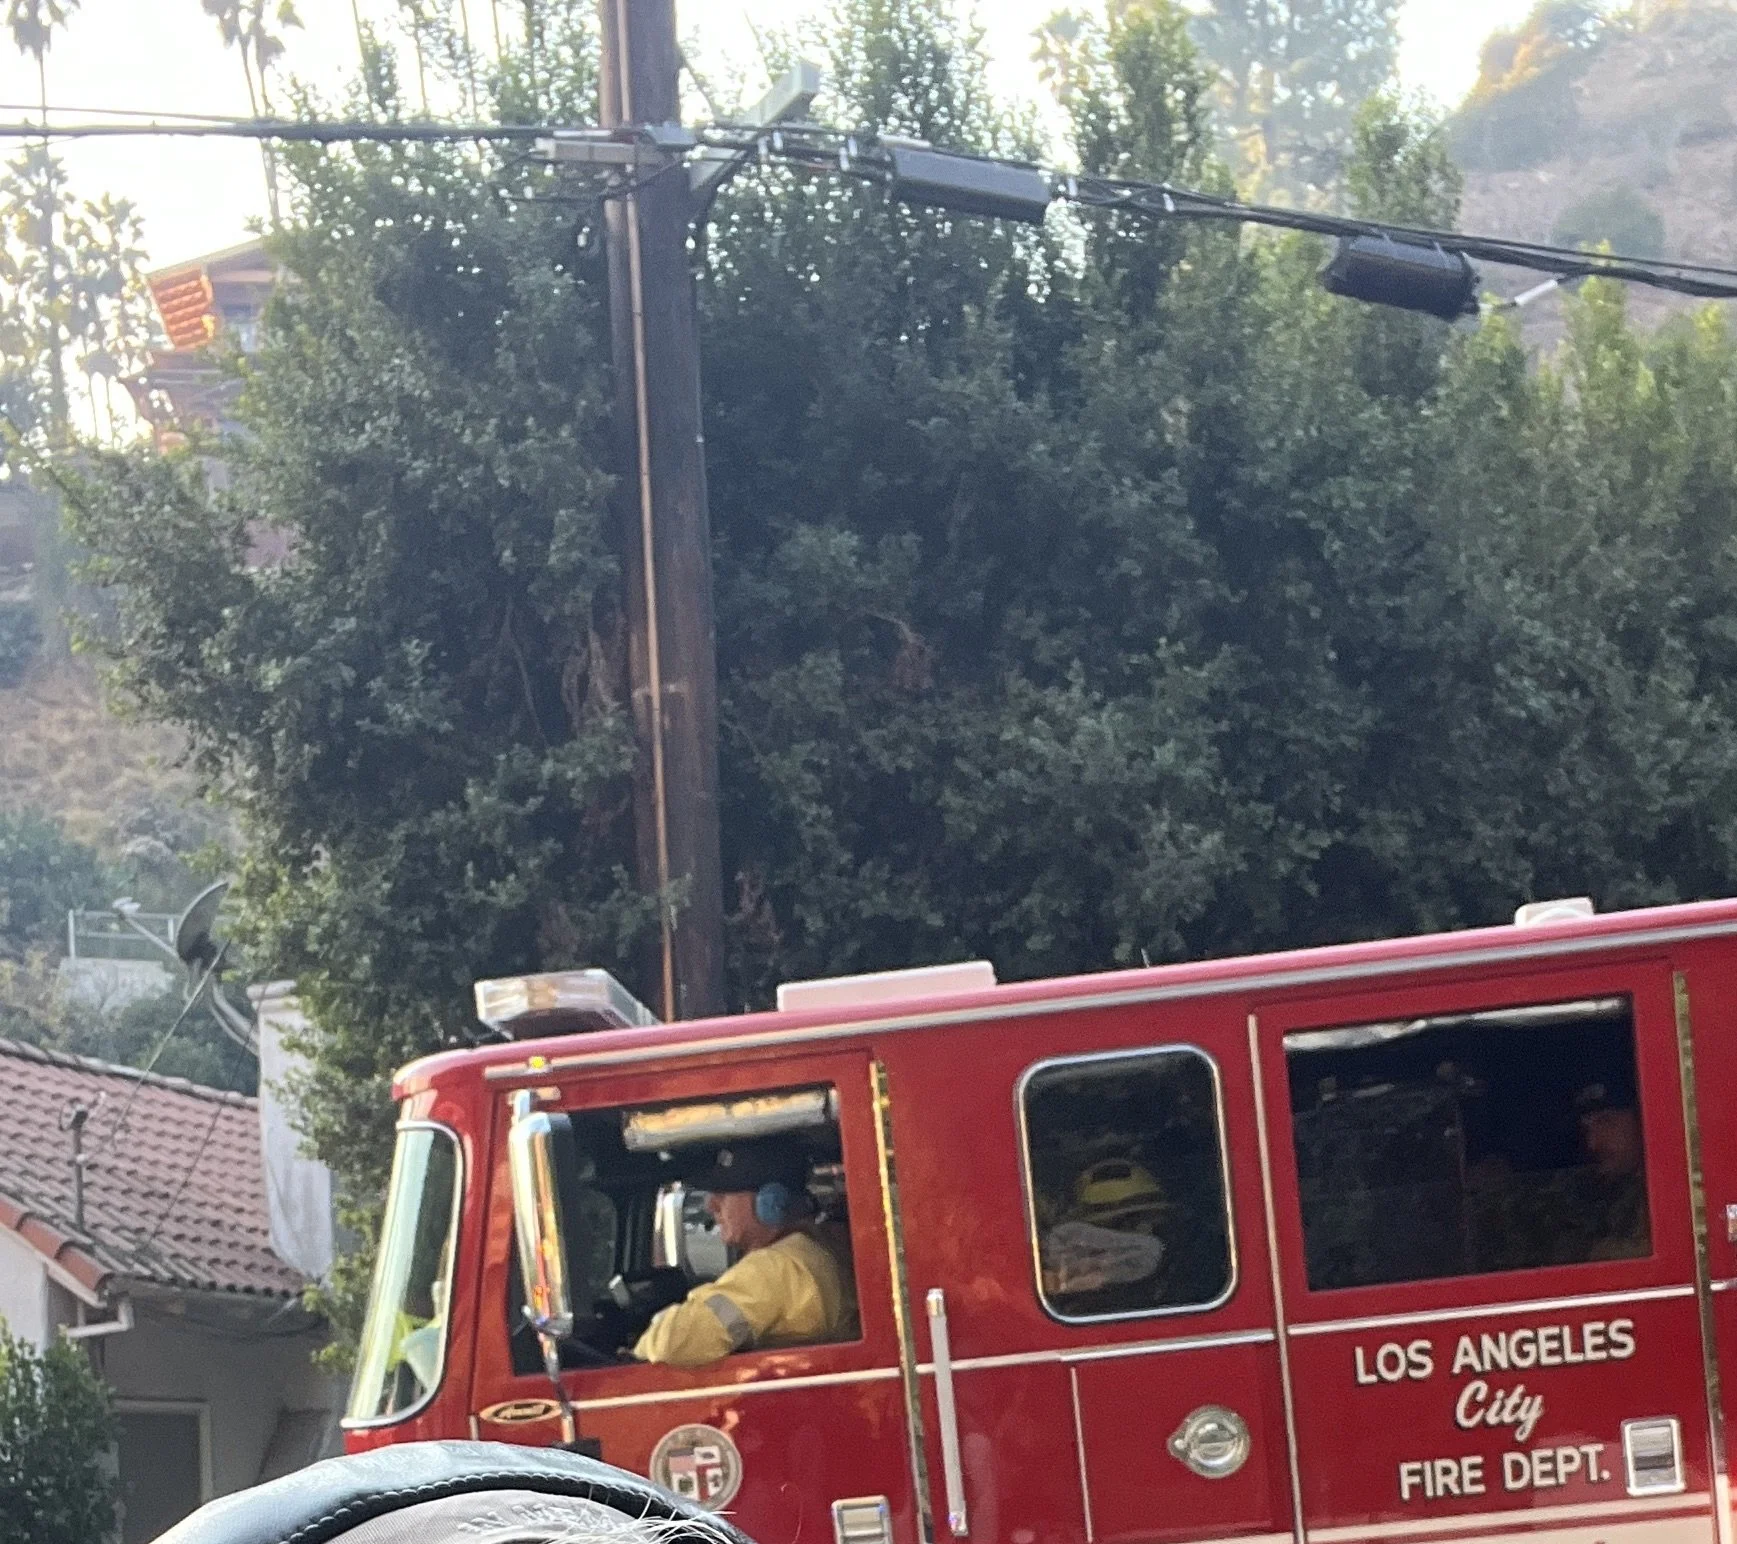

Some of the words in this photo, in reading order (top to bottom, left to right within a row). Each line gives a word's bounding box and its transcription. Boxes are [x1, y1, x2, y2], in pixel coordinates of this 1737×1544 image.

[1354, 1338, 1434, 1385] LOS
[1451, 1318, 1637, 1375] ANGELES
[1455, 1380, 1545, 1442] City
[1399, 1454, 1486, 1501] FIRE
[1503, 1443, 1611, 1491] DEPT.
